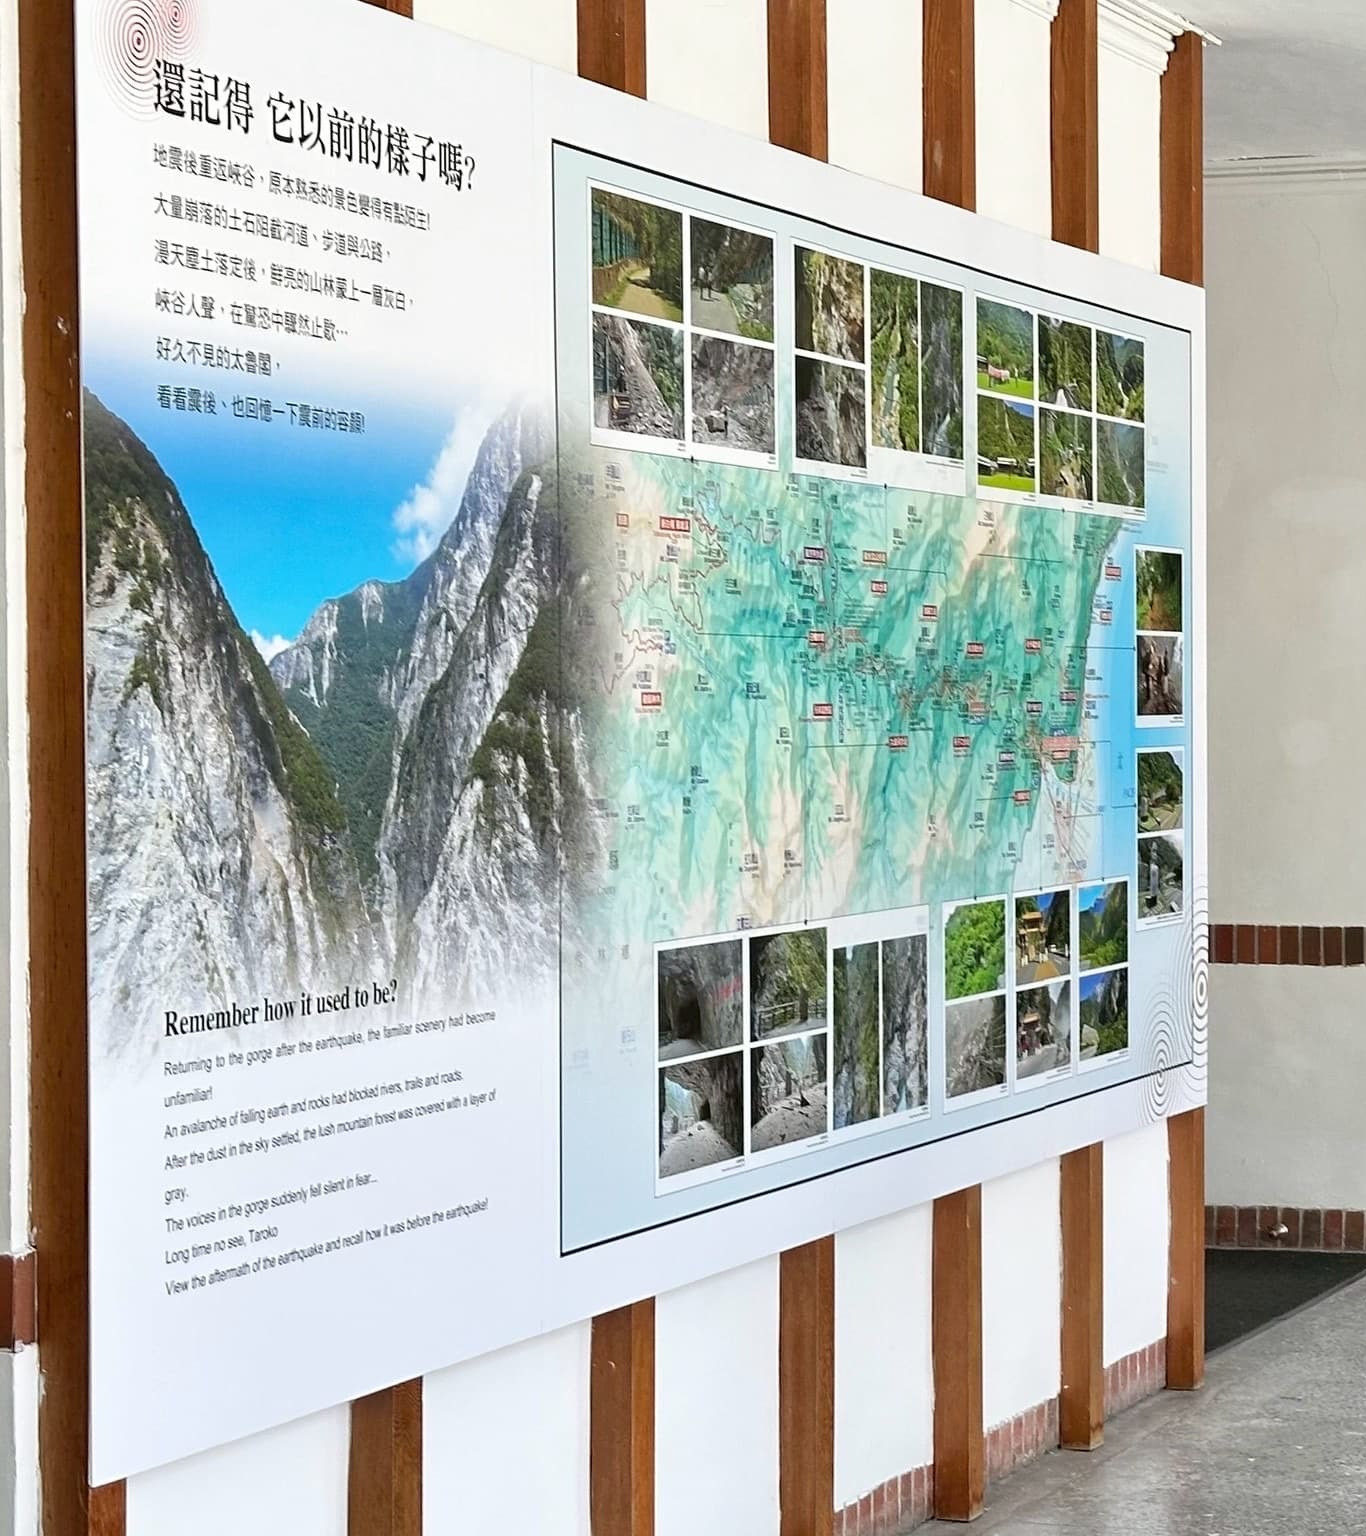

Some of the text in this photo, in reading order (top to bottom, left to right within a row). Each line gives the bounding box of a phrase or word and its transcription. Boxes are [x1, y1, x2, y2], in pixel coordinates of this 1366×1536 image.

[153, 58, 475, 192] 還記得 它以前的樣子嗎?
[165, 979, 398, 1037] Remember how it used to be?
[164, 1011, 496, 1076] Returning to the gorge after the earthquake, the familiar scenery had become
[164, 1086, 213, 1107] unfamiliar!
[164, 1069, 463, 1139] An avalanche of falling earth and rocks had blocked rivers, trails and roads.
[164, 1088, 497, 1170] After the dust in the sky settled, the lush mountain forest was covered with a layer of
[164, 1187, 189, 1205] gray.
[165, 1173, 378, 1232] The voices in the gorge suddenly fell silent in fear...
[165, 1226, 279, 1265] Long time no see, Taroko
[165, 1197, 489, 1296] View the aftermath of the earthquake and recall how it was before the earthquake!
